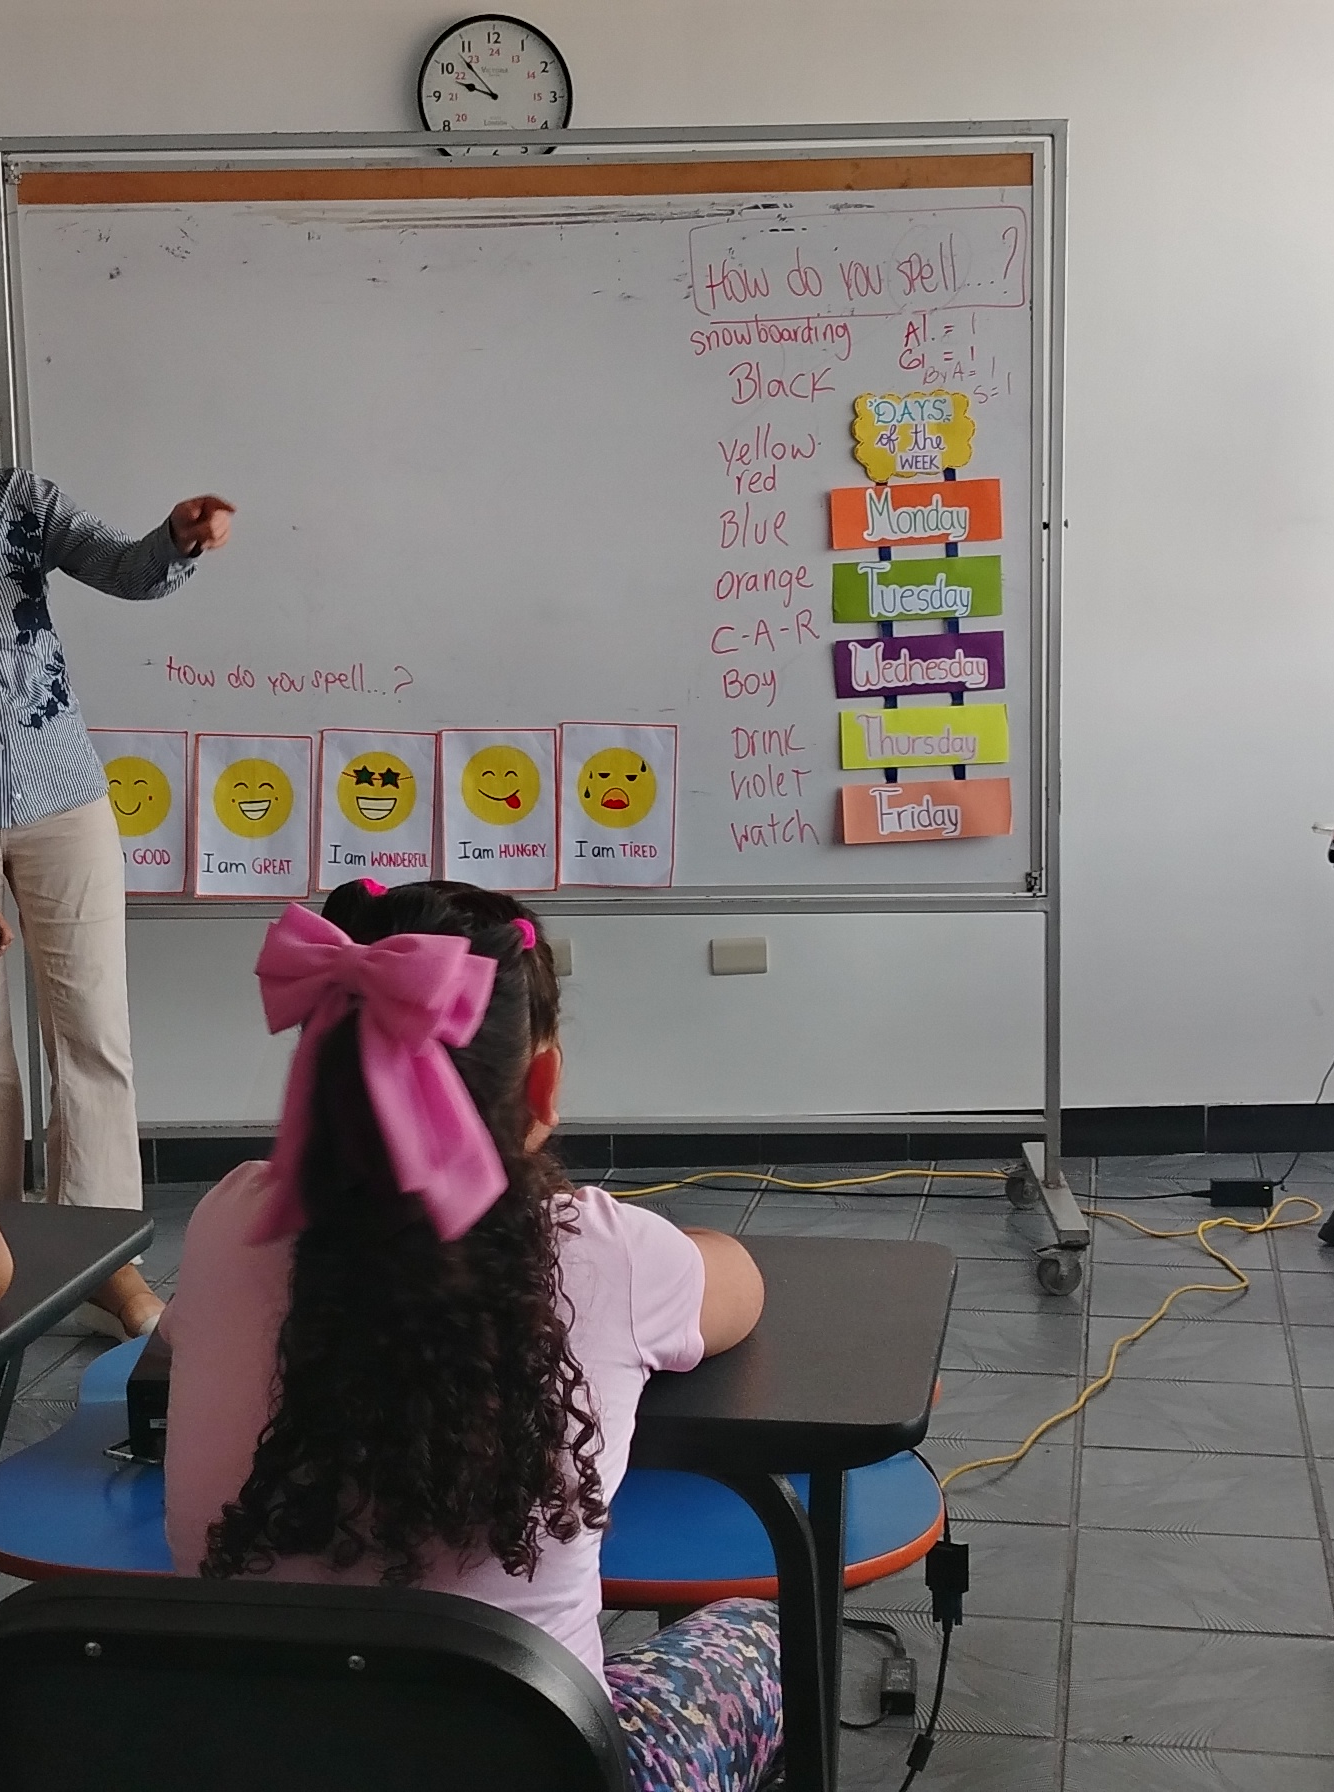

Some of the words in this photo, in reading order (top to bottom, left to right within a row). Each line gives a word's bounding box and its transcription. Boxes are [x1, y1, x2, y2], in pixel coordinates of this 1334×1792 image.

[461, 40, 472, 53] 11
[486, 31, 502, 45] 12
[520, 39, 525, 52] 1
[468, 55, 480, 64] 23
[489, 48, 501, 57] 24
[511, 55, 521, 64] 13
[440, 62, 455, 75] 10
[454, 72, 466, 80] 22
[526, 71, 536, 80] 14
[539, 61, 550, 74] 2
[432, 90, 442, 103] 9
[448, 92, 458, 101] 21
[533, 92, 542, 101] 15
[549, 91, 558, 103] 3
[442, 119, 452, 132] 8
[455, 113, 467, 122] 20
[527, 114, 537, 123] 16
[705, 259, 770, 310] How
[786, 247, 823, 297] do
[690, 313, 851, 361] snowboarding
[872, 398, 948, 424] DAYS
[876, 424, 899, 454] of
[908, 423, 946, 451] the
[899, 454, 940, 471] WEEK
[735, 463, 778, 496] red
[865, 490, 970, 540] Monday
[719, 501, 790, 550] Blue
[858, 563, 971, 618] Tuesday
[850, 643, 988, 689] Wednesday
[166, 655, 216, 689] How
[227, 664, 255, 689] do
[267, 671, 305, 696] you
[722, 668, 777, 708] Boy
[857, 713, 977, 761] Thursday
[870, 789, 960, 836] Friday
[132, 847, 172, 866] GOOD
[471, 845, 495, 860] am
[498, 843, 548, 859] HUNGRY
[591, 841, 616, 858] am
[217, 860, 248, 875] am
[251, 856, 293, 876] GREAT
[343, 850, 367, 867] am
[370, 850, 430, 869] WONDERFUL
